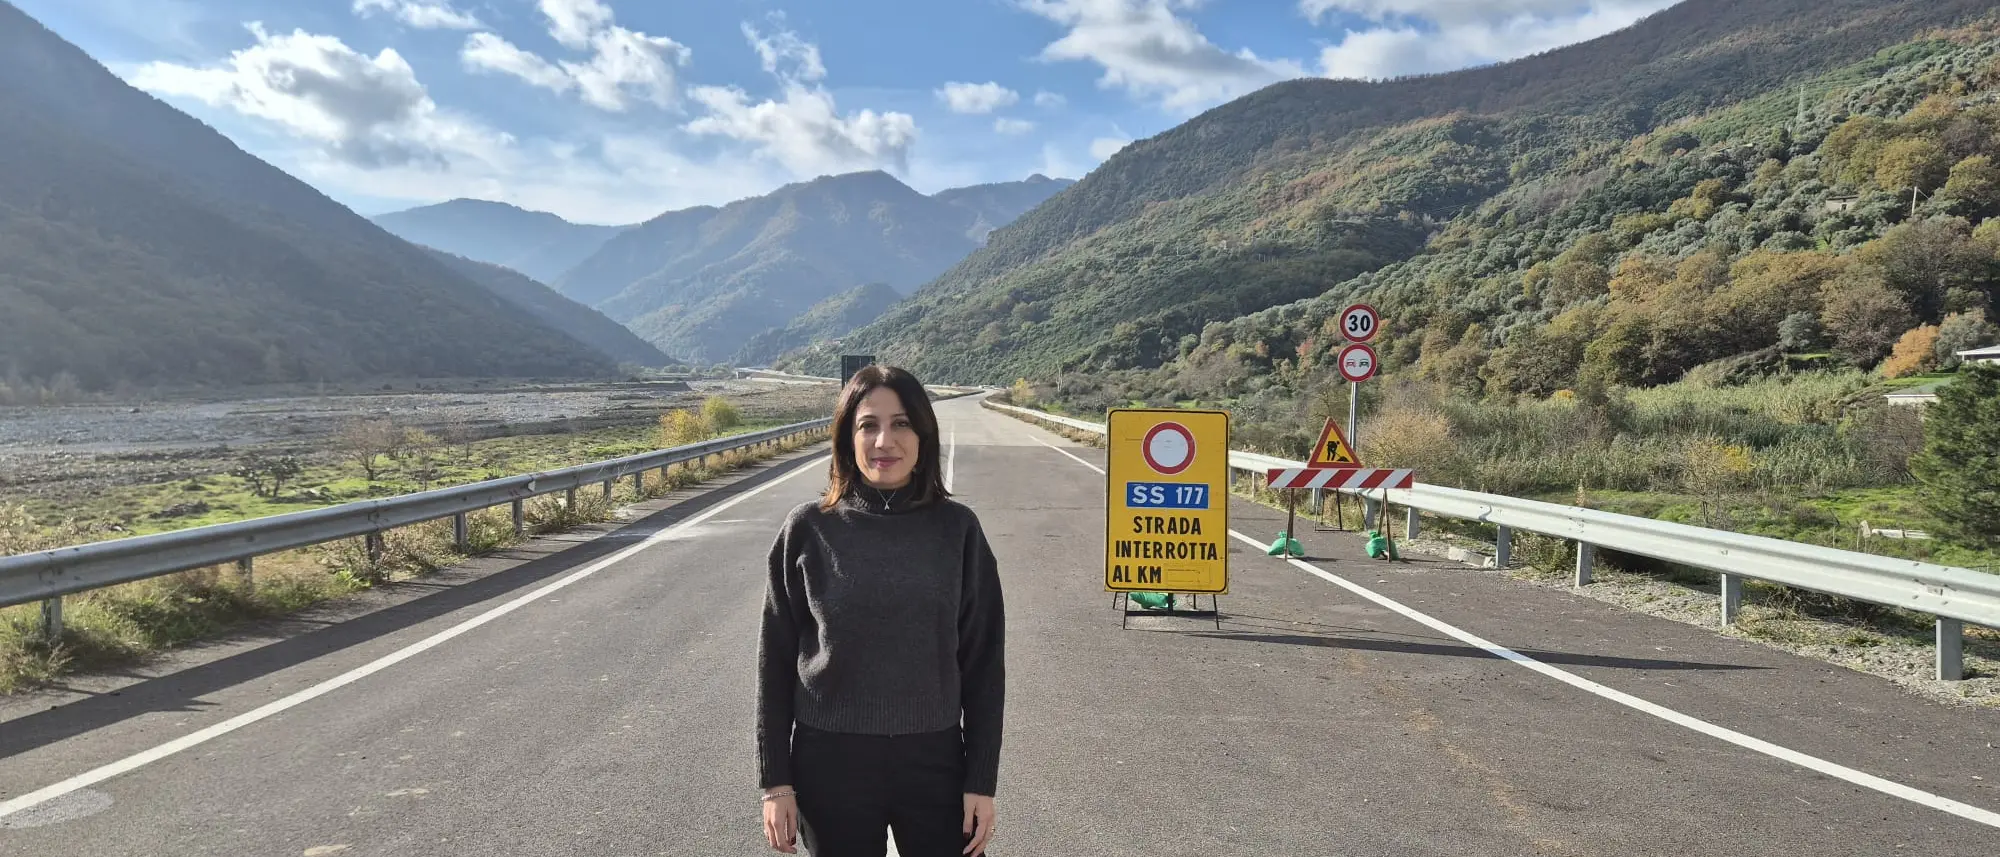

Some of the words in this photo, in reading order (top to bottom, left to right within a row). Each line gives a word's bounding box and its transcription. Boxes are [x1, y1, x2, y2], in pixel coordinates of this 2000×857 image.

[1348, 314, 1371, 332] 30
[1133, 485, 1165, 504] SS
[1175, 486, 1203, 505] 177
[1133, 516, 1202, 535] STRADA
[1115, 540, 1218, 560] INTERROTTA
[1112, 565, 1132, 583] AL
[1137, 565, 1162, 583] KM
